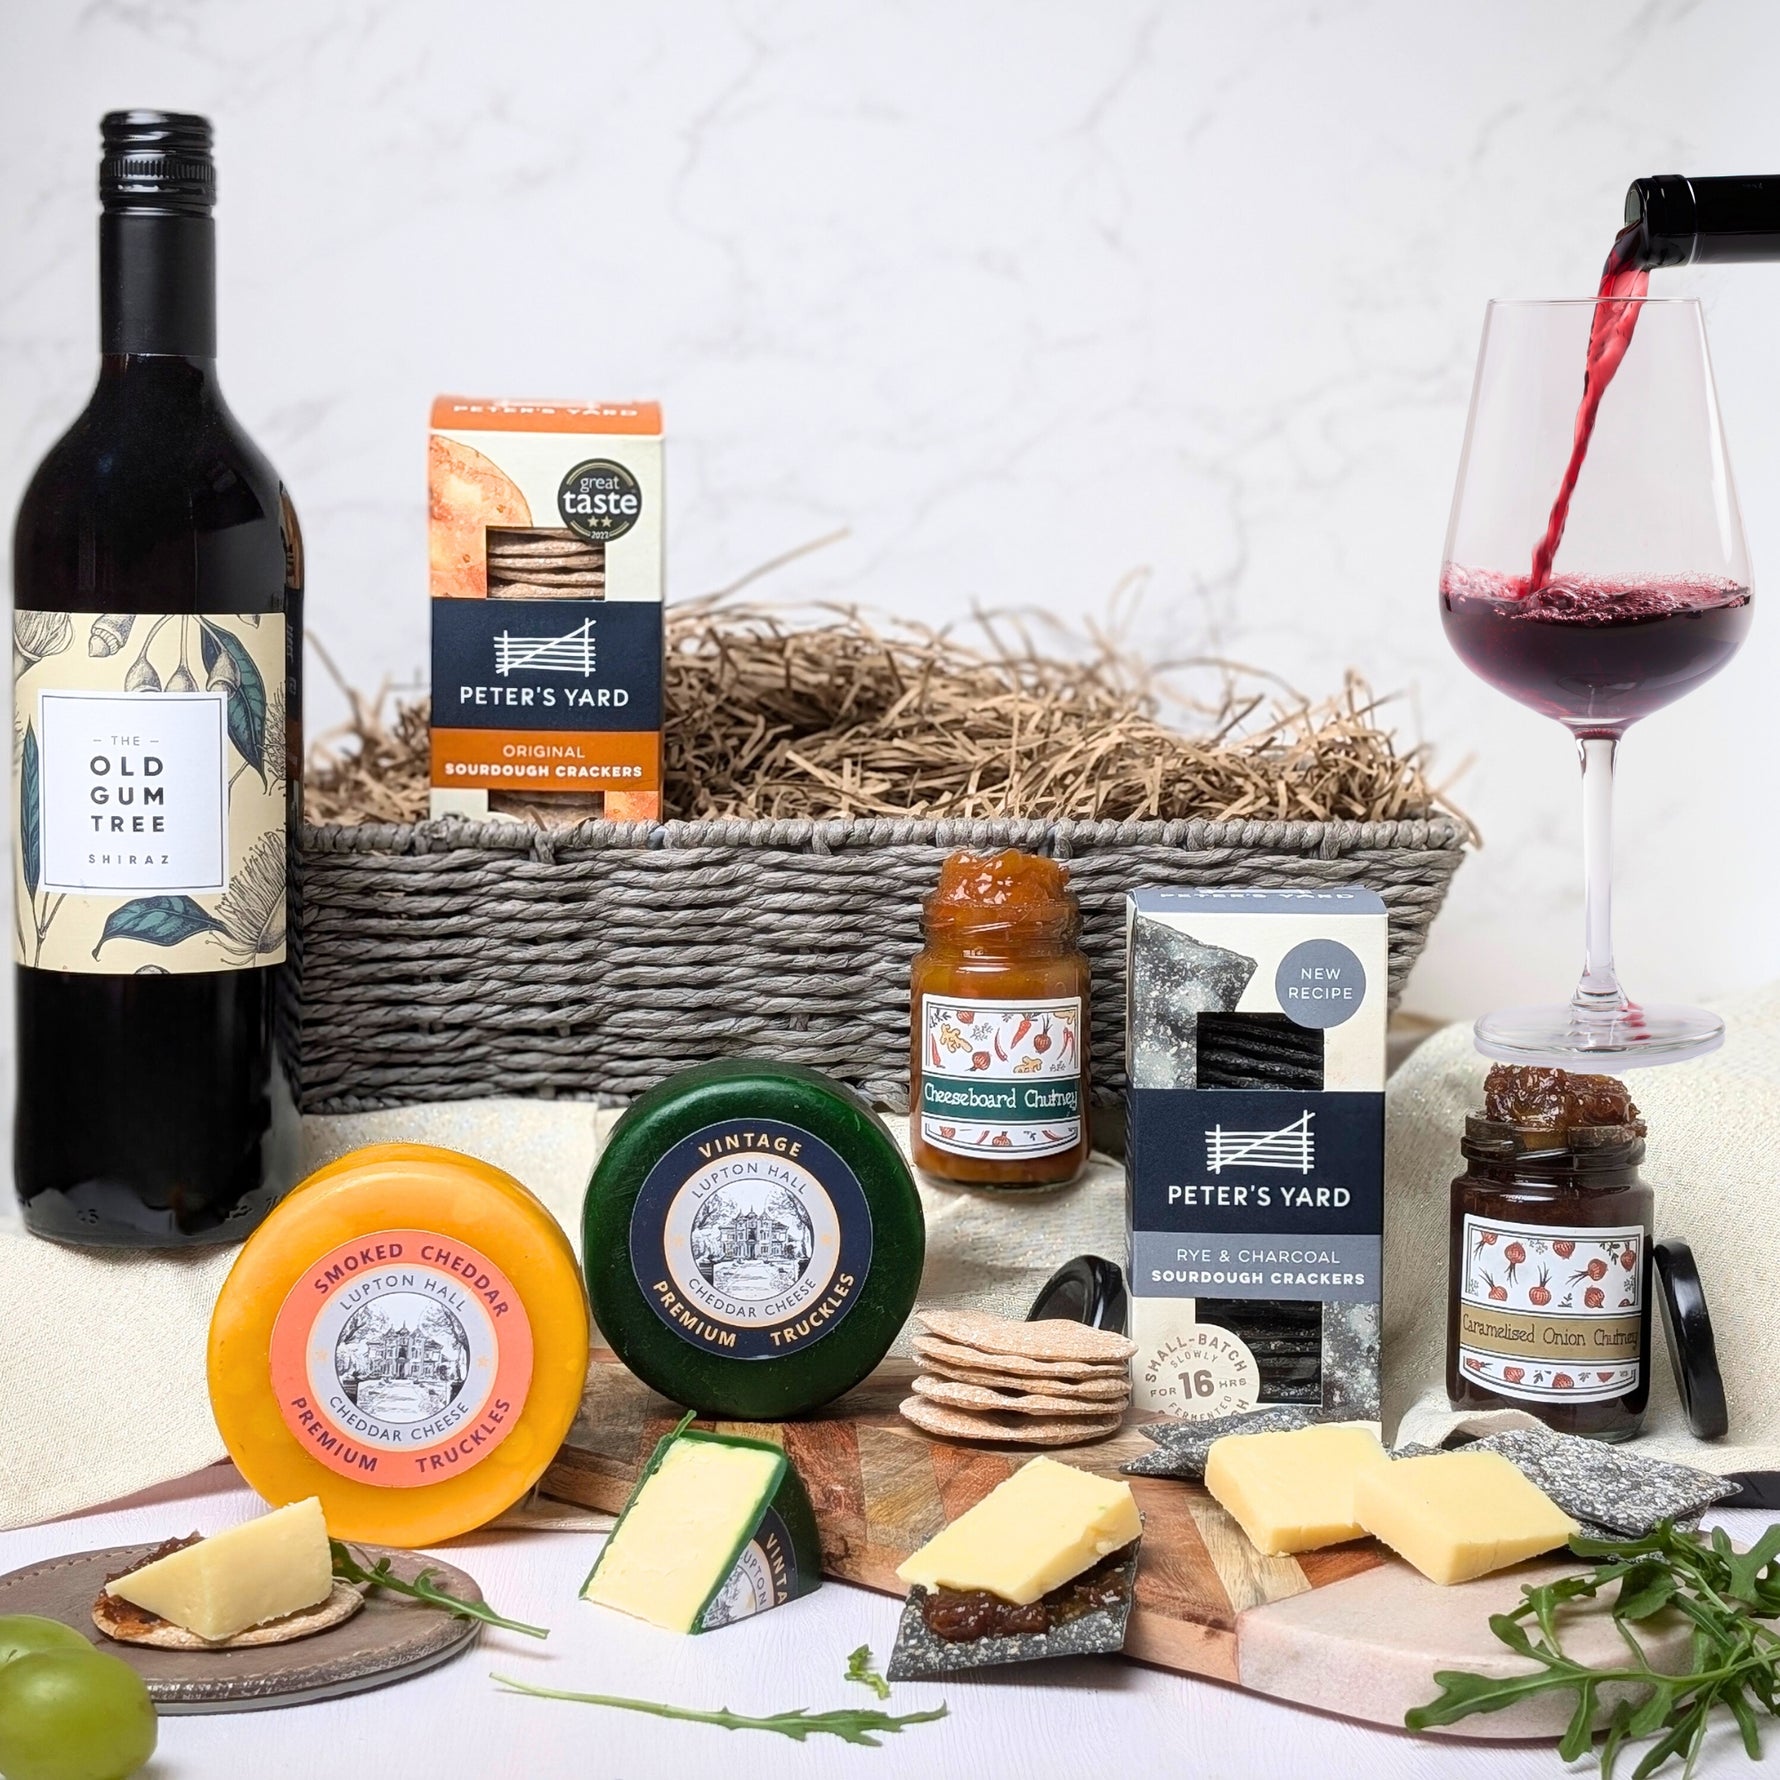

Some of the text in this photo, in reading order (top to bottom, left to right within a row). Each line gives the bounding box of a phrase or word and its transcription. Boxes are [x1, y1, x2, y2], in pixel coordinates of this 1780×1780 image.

[566, 407, 638, 417] YARD
[580, 476, 620, 493] great
[563, 491, 638, 514] taste
[591, 530, 610, 539] 2022
[460, 686, 629, 707] PETER'S YARD
[112, 736, 140, 746] THE
[503, 744, 585, 758] ORIGINAL
[90, 756, 164, 777] OLD
[445, 763, 642, 778] SOURDOUGH CRACKERS
[90, 787, 164, 806] GUM
[91, 816, 165, 832] TREE
[88, 854, 169, 865] SHIRAZ
[1301, 968, 1341, 980] NEW
[1288, 987, 1352, 1000] RECIPE
[924, 1082, 1078, 1110] Cheeseboard Chutney
[698, 1133, 802, 1158] VINTAGE
[691, 1162, 808, 1198] LUPTON HALL
[1168, 1186, 1351, 1208] PETER'S YARD
[1177, 1249, 1340, 1264] RYE & CHARCOAL
[314, 1243, 509, 1318] SMOKED CHEDDAR
[1151, 1270, 1365, 1285] SOURDOUGH CRACKERS
[340, 1275, 466, 1312] LUPTON HALL
[688, 1278, 816, 1318] CHEDDAR CHEESE
[653, 1274, 855, 1348] PREMIUM TRUCKLES
[1462, 1314, 1638, 1350] Caramelised Onion Chutney
[1145, 1333, 1248, 1383] SMALL-BATCH
[1170, 1350, 1218, 1369] SLOWLY
[1150, 1370, 1246, 1400] FOR 16 HRS
[1168, 1396, 1232, 1420] FERMENTED
[330, 1396, 469, 1442] CHEDDAR CHEESE
[291, 1398, 511, 1472] PREMIUM TRUCKLES
[743, 1550, 766, 1606] UPTON
